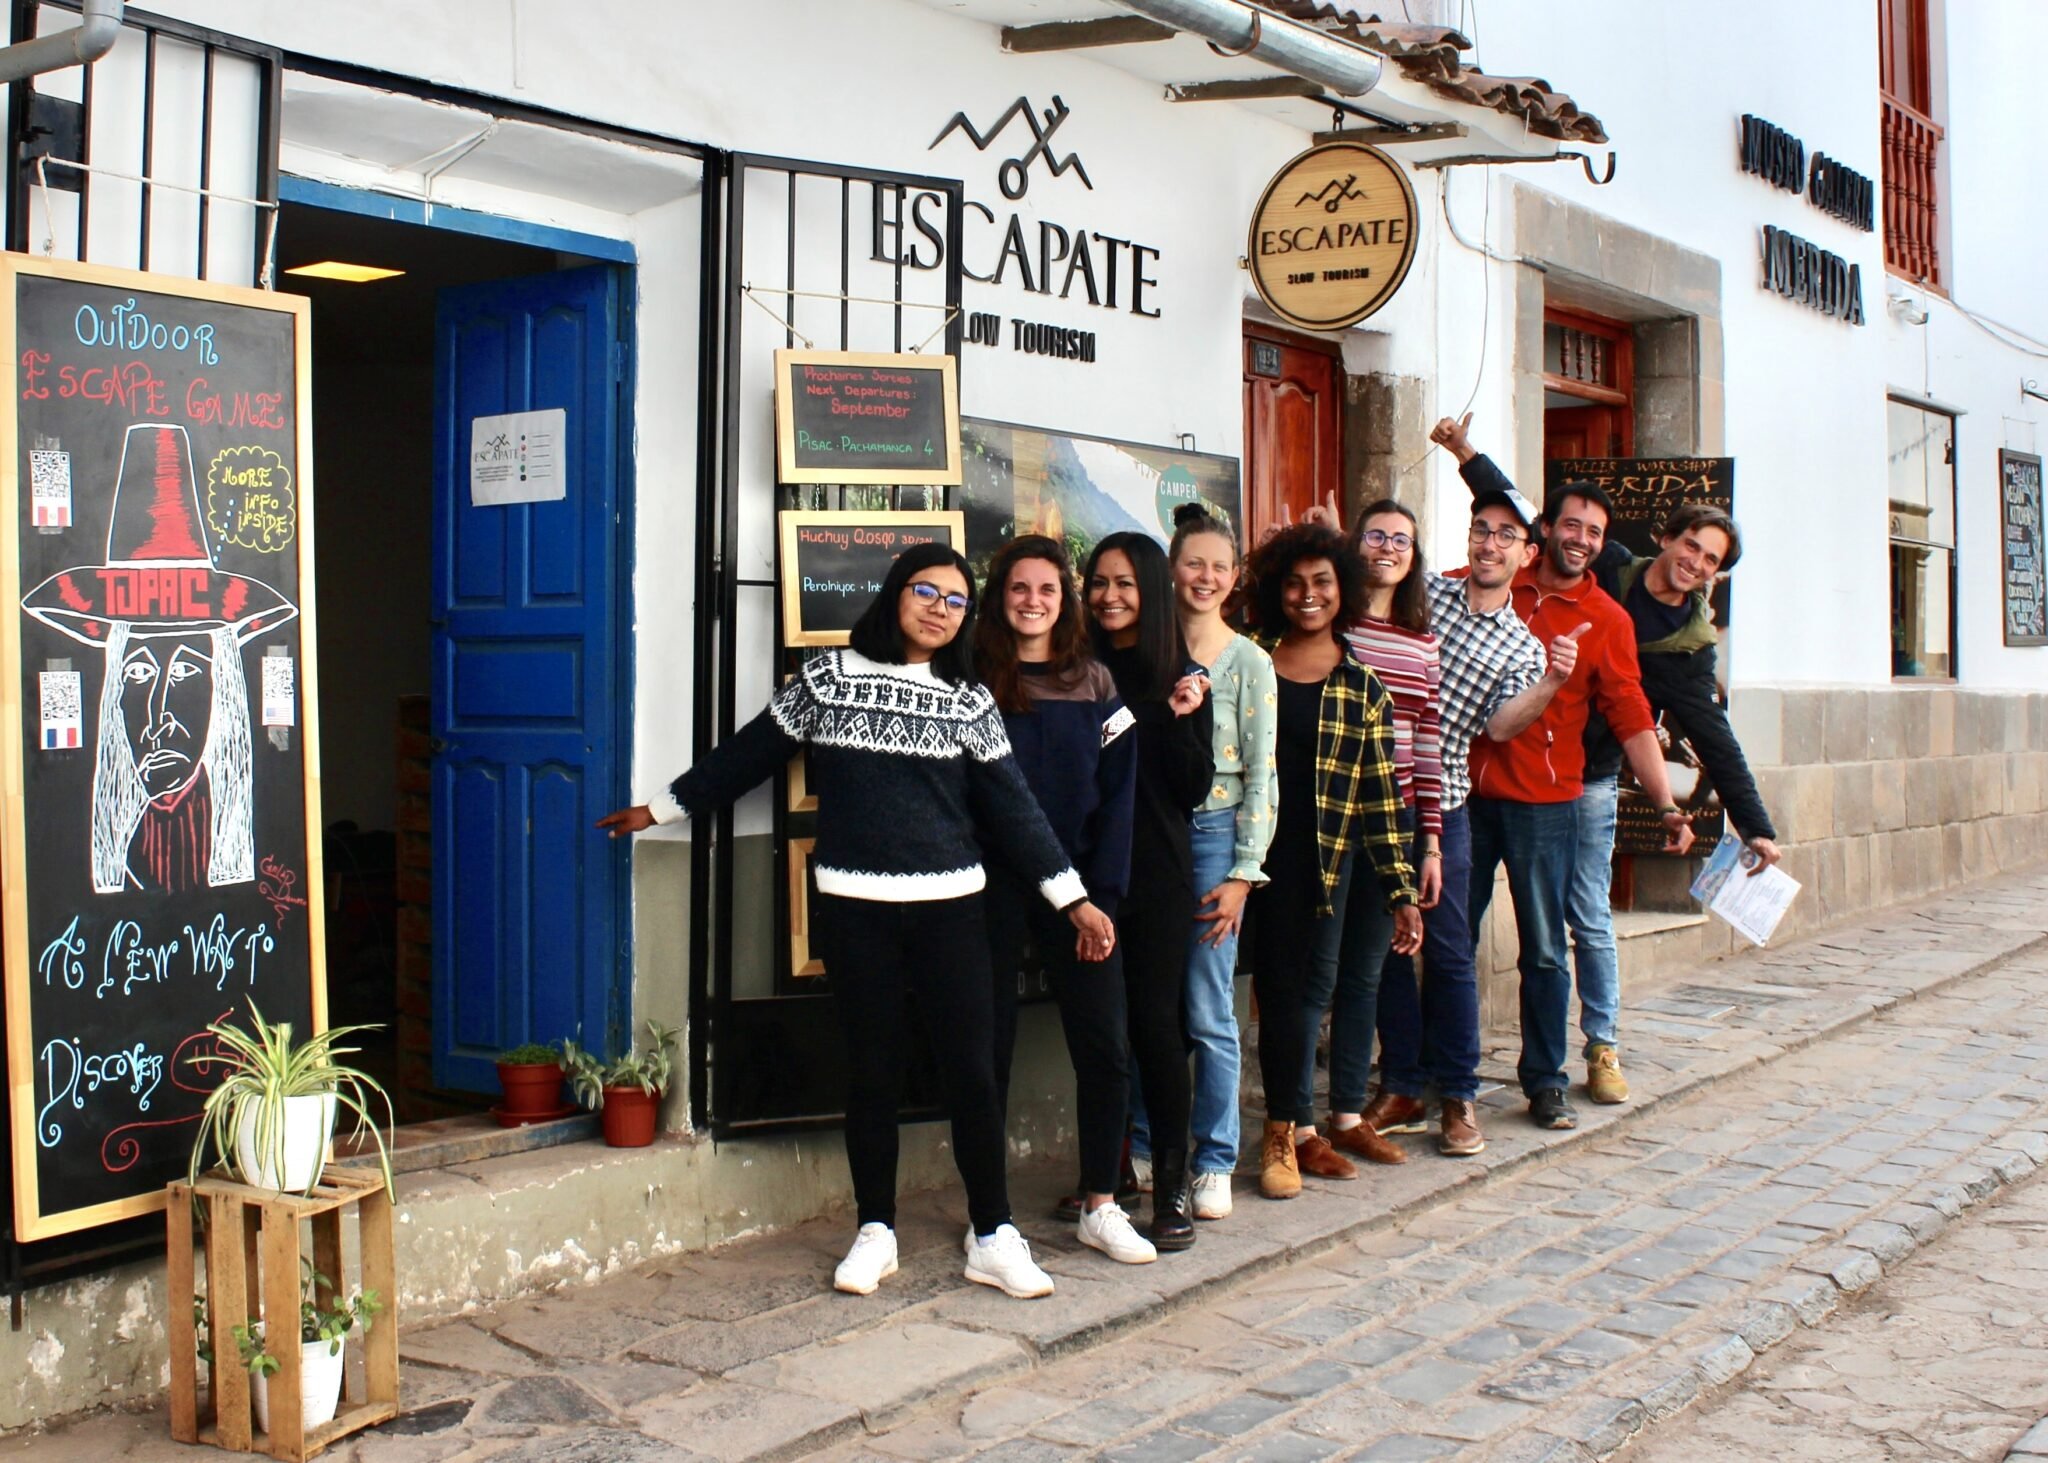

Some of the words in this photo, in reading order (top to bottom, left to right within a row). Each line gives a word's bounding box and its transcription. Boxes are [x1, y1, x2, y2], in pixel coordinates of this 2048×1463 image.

[1741, 114, 1804, 195] MUSEO
[1260, 219, 1405, 256] ESCAPATE
[870, 182, 1161, 318] ESCAPATE
[1287, 272, 1315, 285] SLOW
[1323, 268, 1370, 282] TOURISM
[1763, 225, 1865, 326] MERIDA
[75, 298, 219, 365] OUTDOOR
[960, 308, 1001, 347] LOW
[1011, 318, 1096, 363] TOURISM
[804, 364, 864, 383] Prochaines
[22, 348, 171, 418] ESCAPE
[186, 377, 287, 430] GAME
[806, 385, 836, 396] Next
[831, 397, 911, 419] September
[924, 440, 934, 456] 4
[222, 465, 273, 488] MORE
[1637, 459, 1718, 474] WORKSHOP
[1160, 480, 1198, 499] CAMPER
[1561, 474, 1719, 497] ERIDA
[800, 530, 850, 550] Huchuy
[854, 528, 896, 550] Qosqo
[96, 569, 210, 618] TUPAC
[38, 915, 86, 989] A
[96, 919, 179, 998] NEW
[183, 912, 246, 991] WAY
